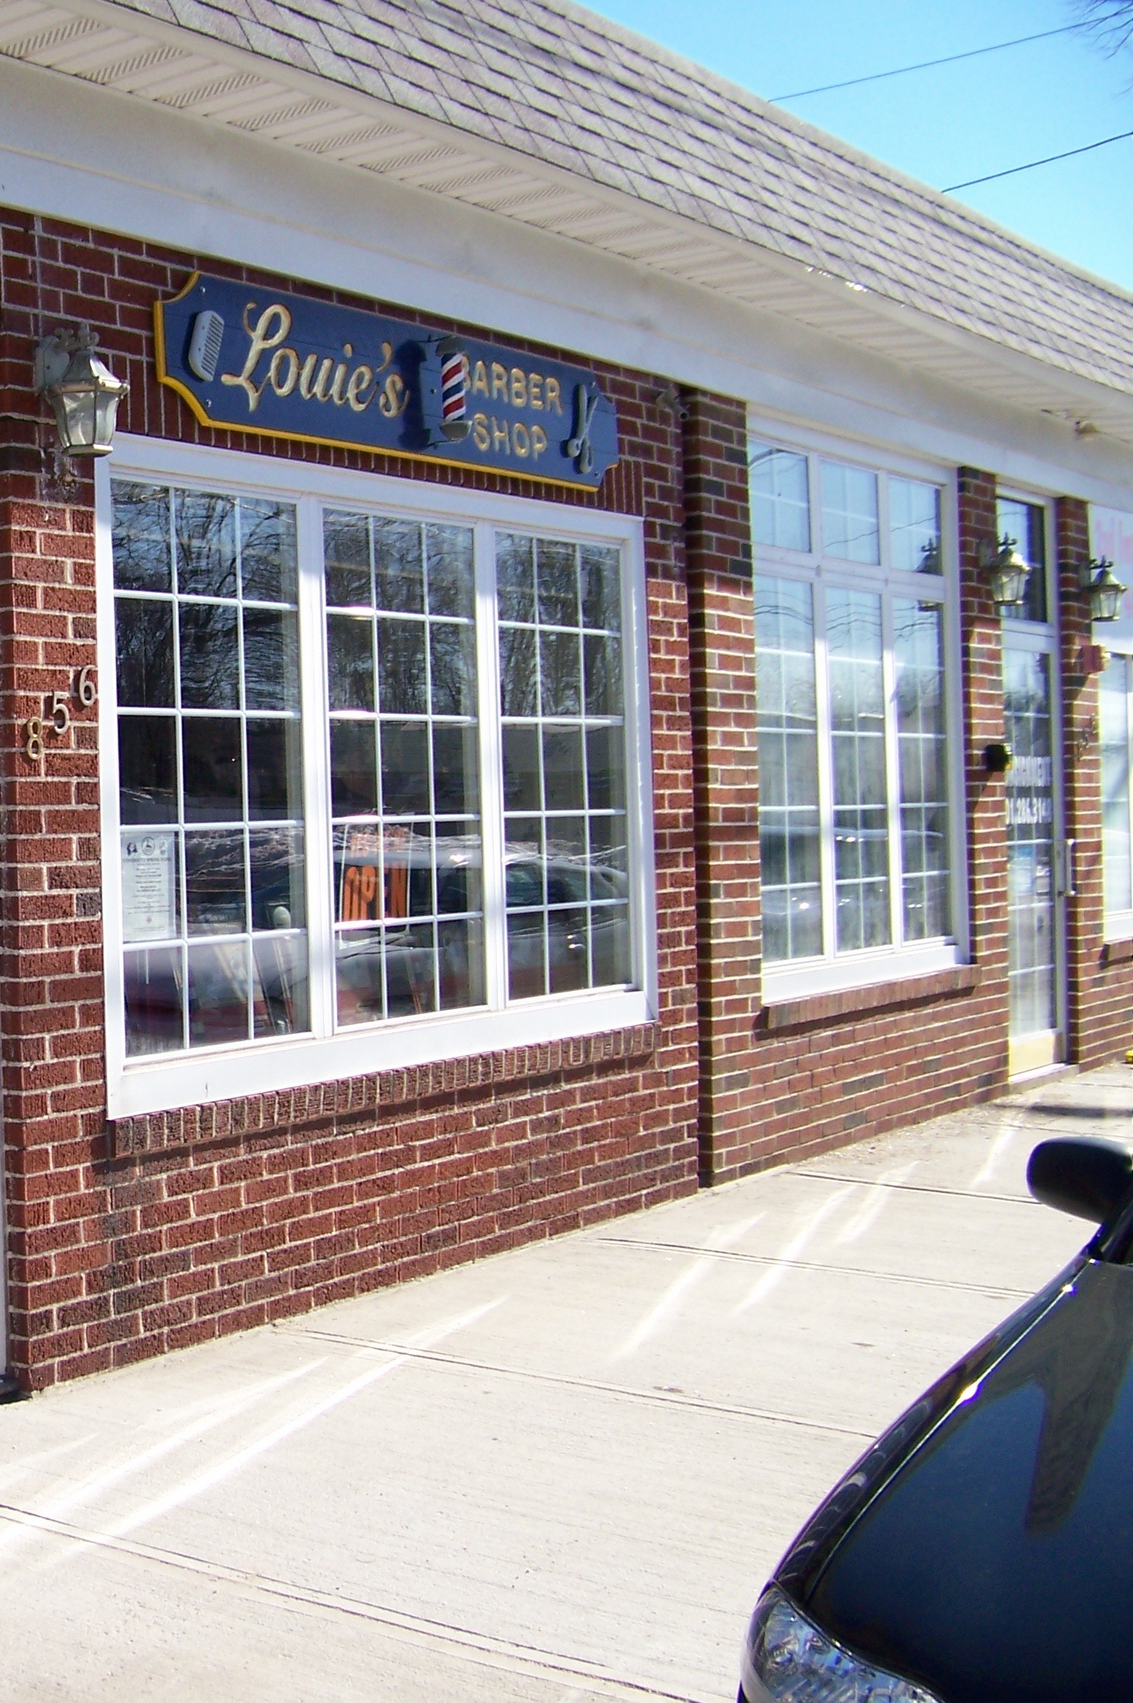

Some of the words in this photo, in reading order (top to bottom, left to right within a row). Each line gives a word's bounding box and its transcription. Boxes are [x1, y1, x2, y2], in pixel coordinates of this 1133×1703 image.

[221, 301, 410, 418] Louie's
[473, 411, 548, 461] SHOP
[27, 664, 97, 761] 856
